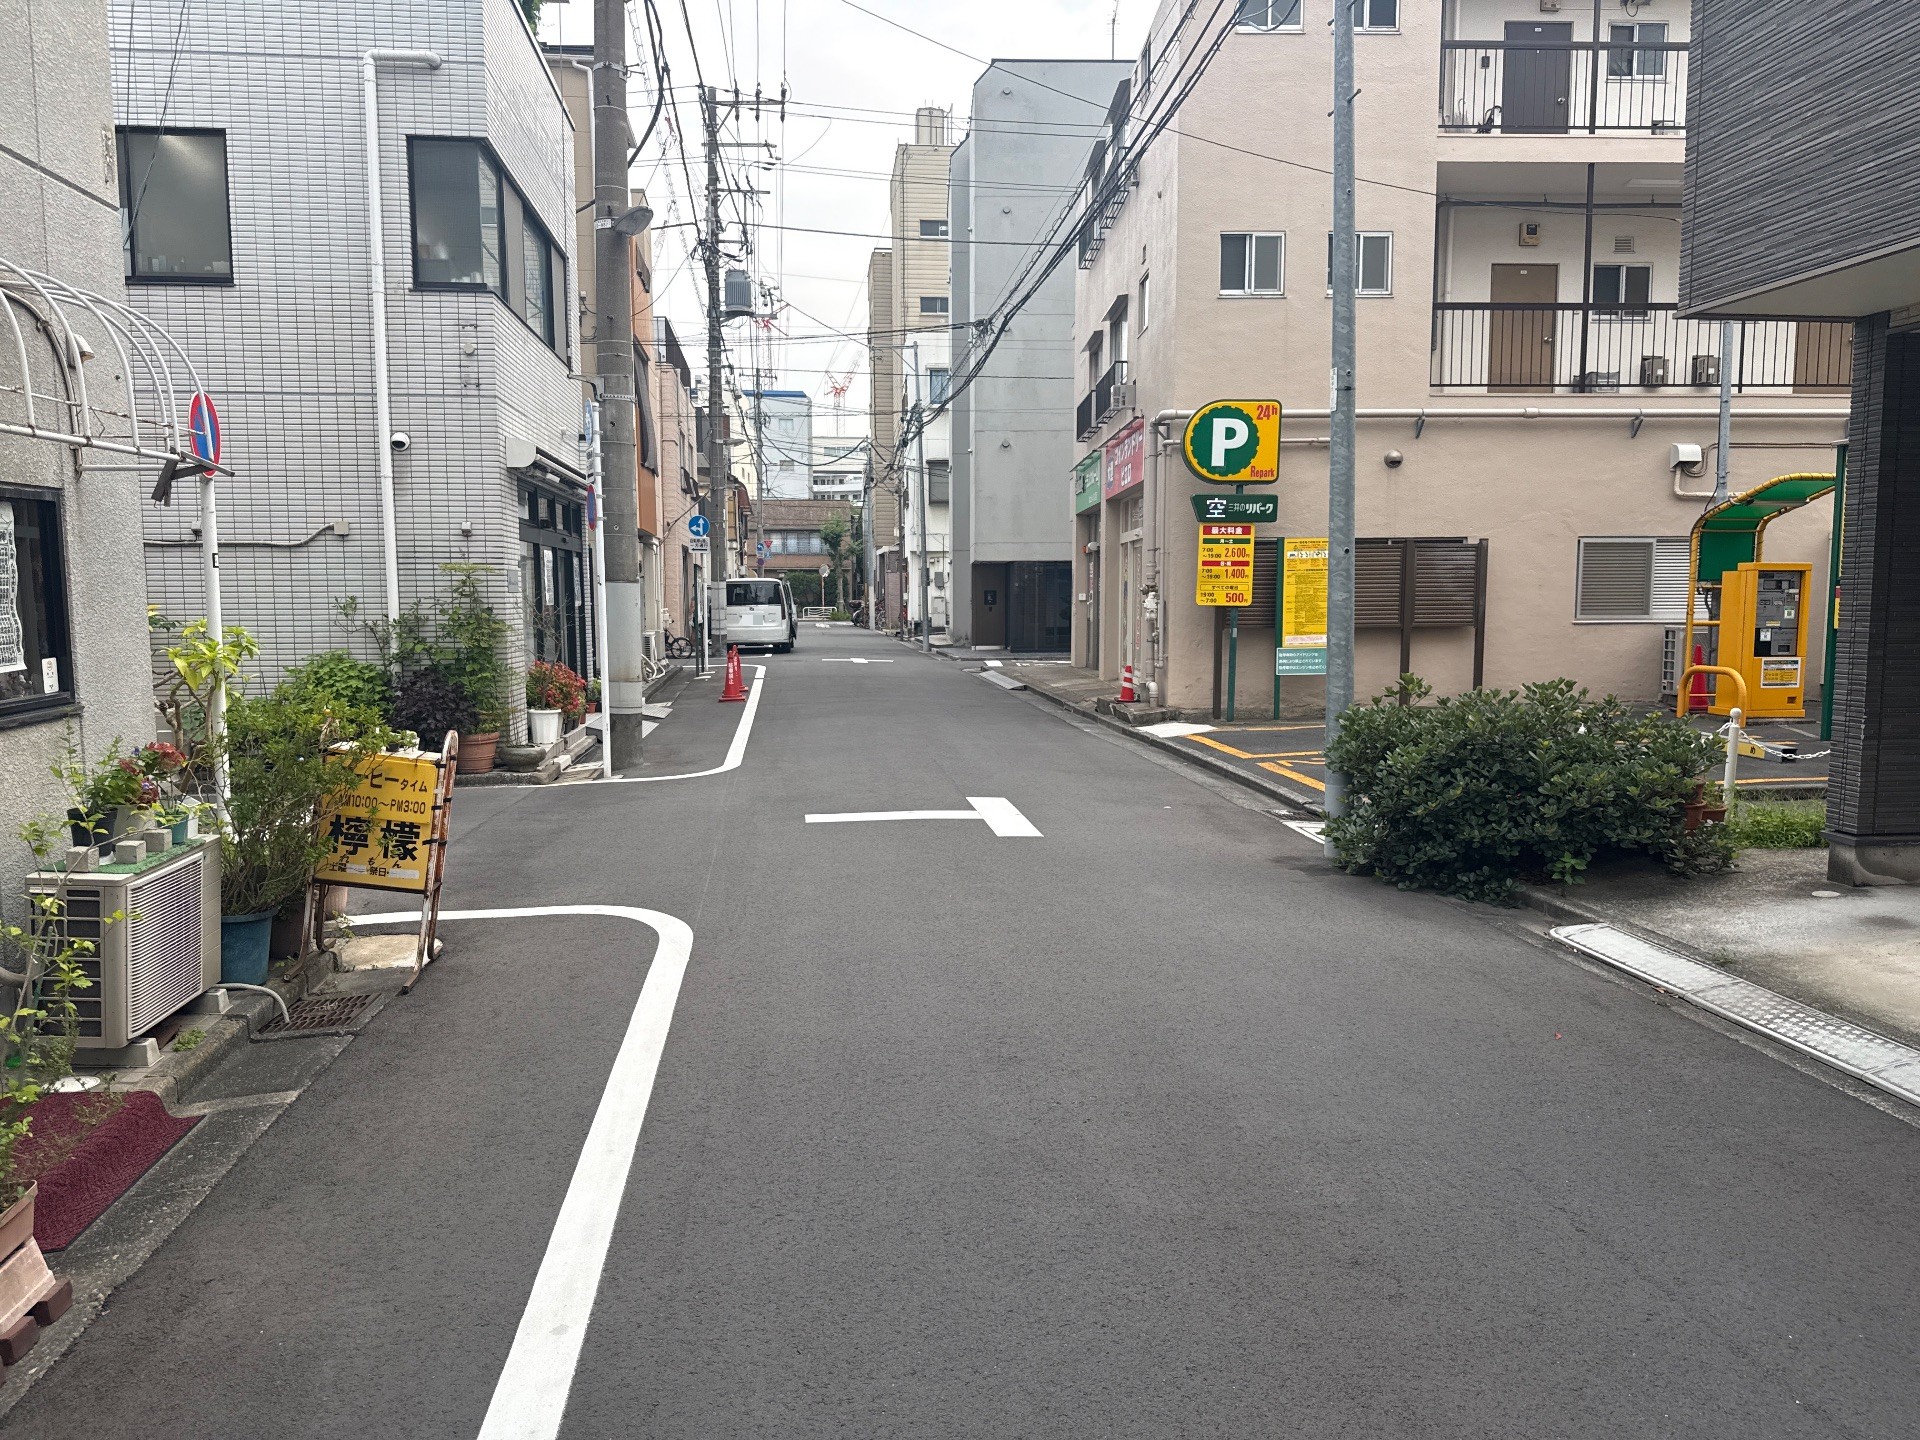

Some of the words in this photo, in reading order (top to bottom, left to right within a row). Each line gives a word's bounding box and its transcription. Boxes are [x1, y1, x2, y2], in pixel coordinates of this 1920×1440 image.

[1256, 404, 1278, 421] 24h
[1210, 417, 1249, 467] P
[1250, 466, 1275, 478] Repark
[1205, 497, 1227, 518] 空
[1228, 503, 1273, 515] 三井のリパーク
[1211, 526, 1243, 535] 最大料金
[355, 769, 428, 793] ーヒータイム
